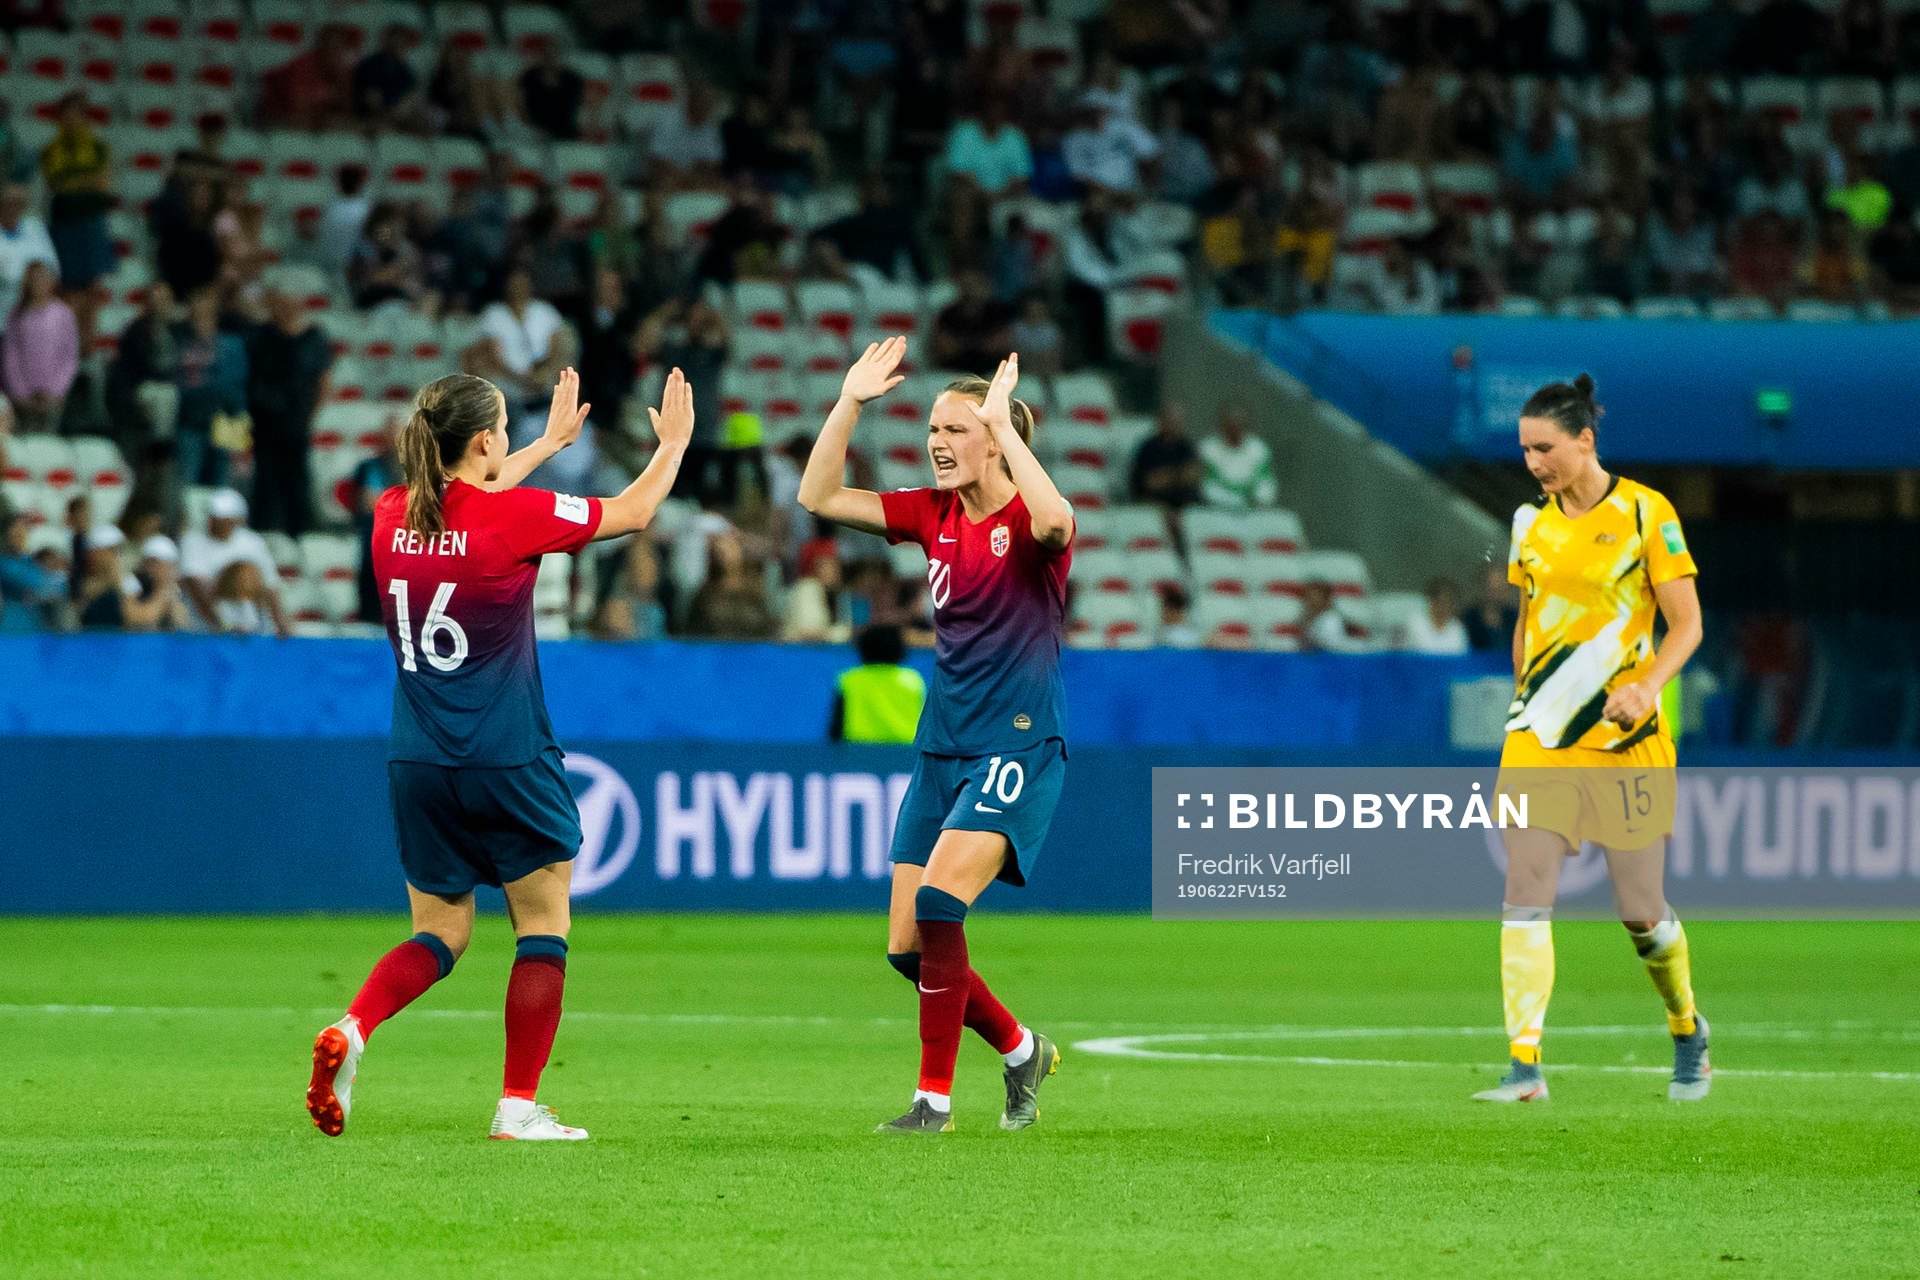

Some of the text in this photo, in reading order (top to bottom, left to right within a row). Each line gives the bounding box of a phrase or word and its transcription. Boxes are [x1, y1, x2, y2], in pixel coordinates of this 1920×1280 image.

[388, 578, 469, 673] 16
[981, 756, 1024, 804] 10
[1616, 774, 1652, 821] 15
[655, 770, 914, 880] HYUN
